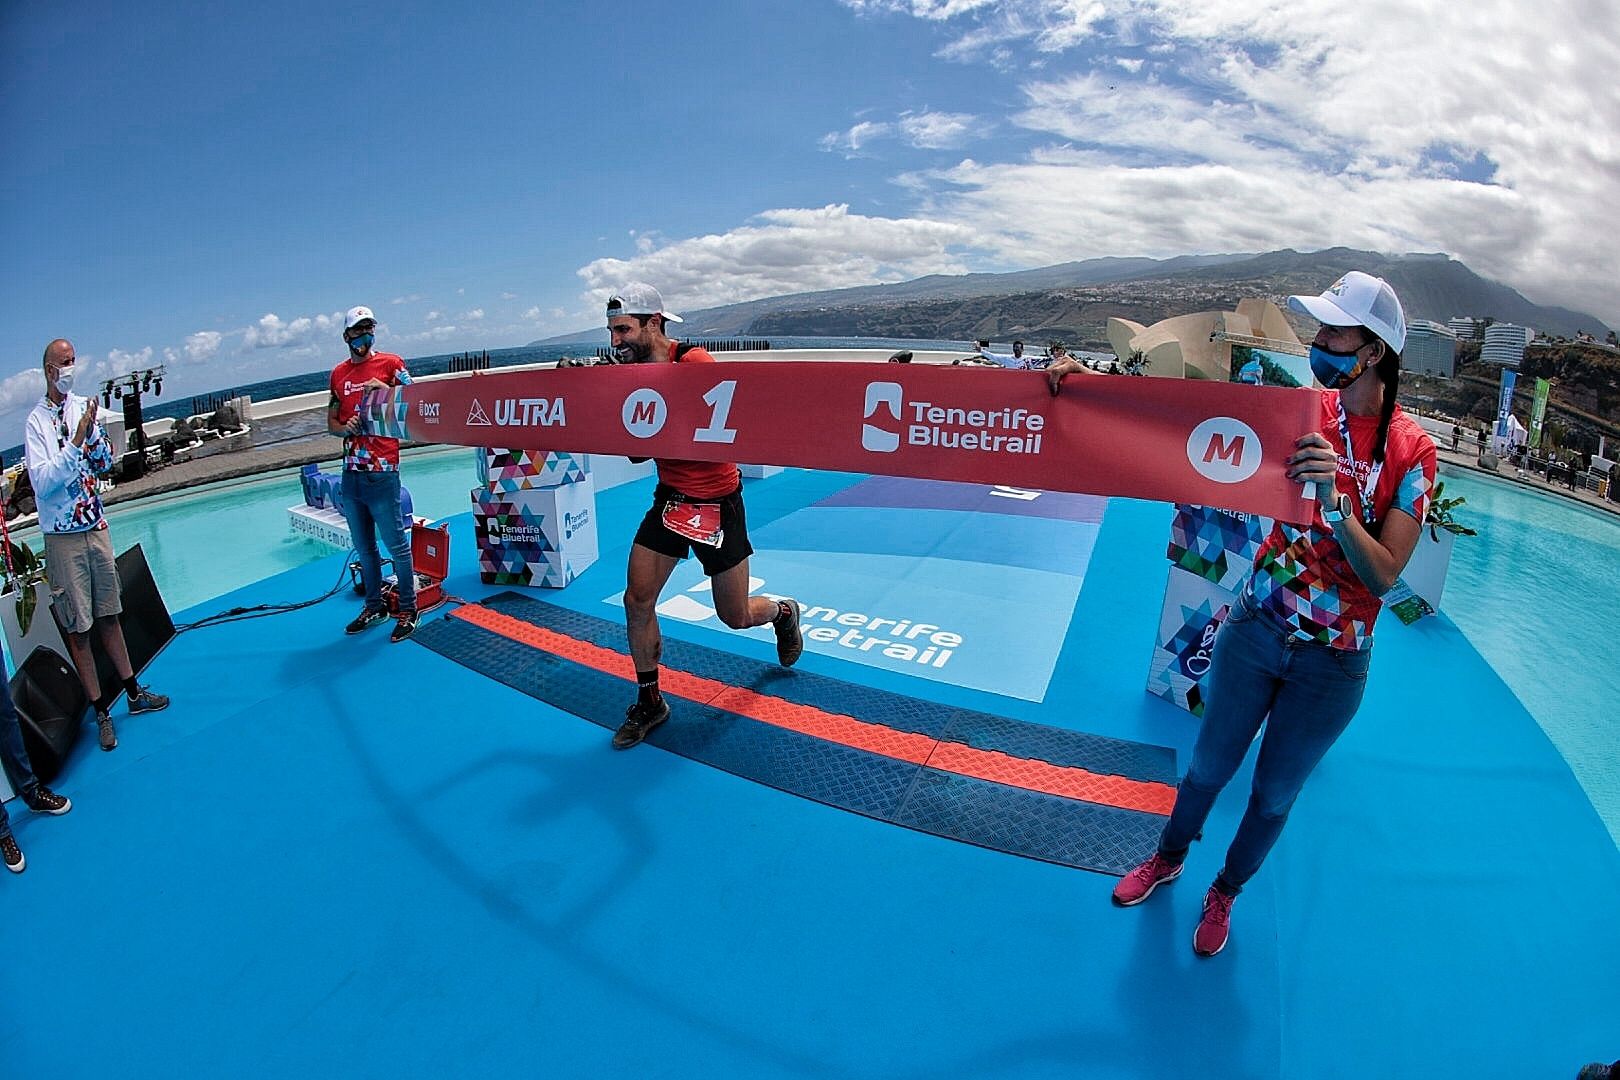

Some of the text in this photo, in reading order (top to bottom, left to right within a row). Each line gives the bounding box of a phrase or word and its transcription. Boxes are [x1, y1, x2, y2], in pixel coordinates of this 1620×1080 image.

[424, 402, 440, 417] DXT
[494, 397, 566, 427] ULTRA
[631, 401, 657, 425] M
[693, 381, 737, 444] 1
[908, 401, 1045, 432] Tenerife
[908, 425, 1043, 454] Bluetrail
[1202, 432, 1246, 467] M
[500, 524, 540, 534] Tenerife
[687, 514, 701, 528] 4
[501, 533, 540, 543] Bluetrail
